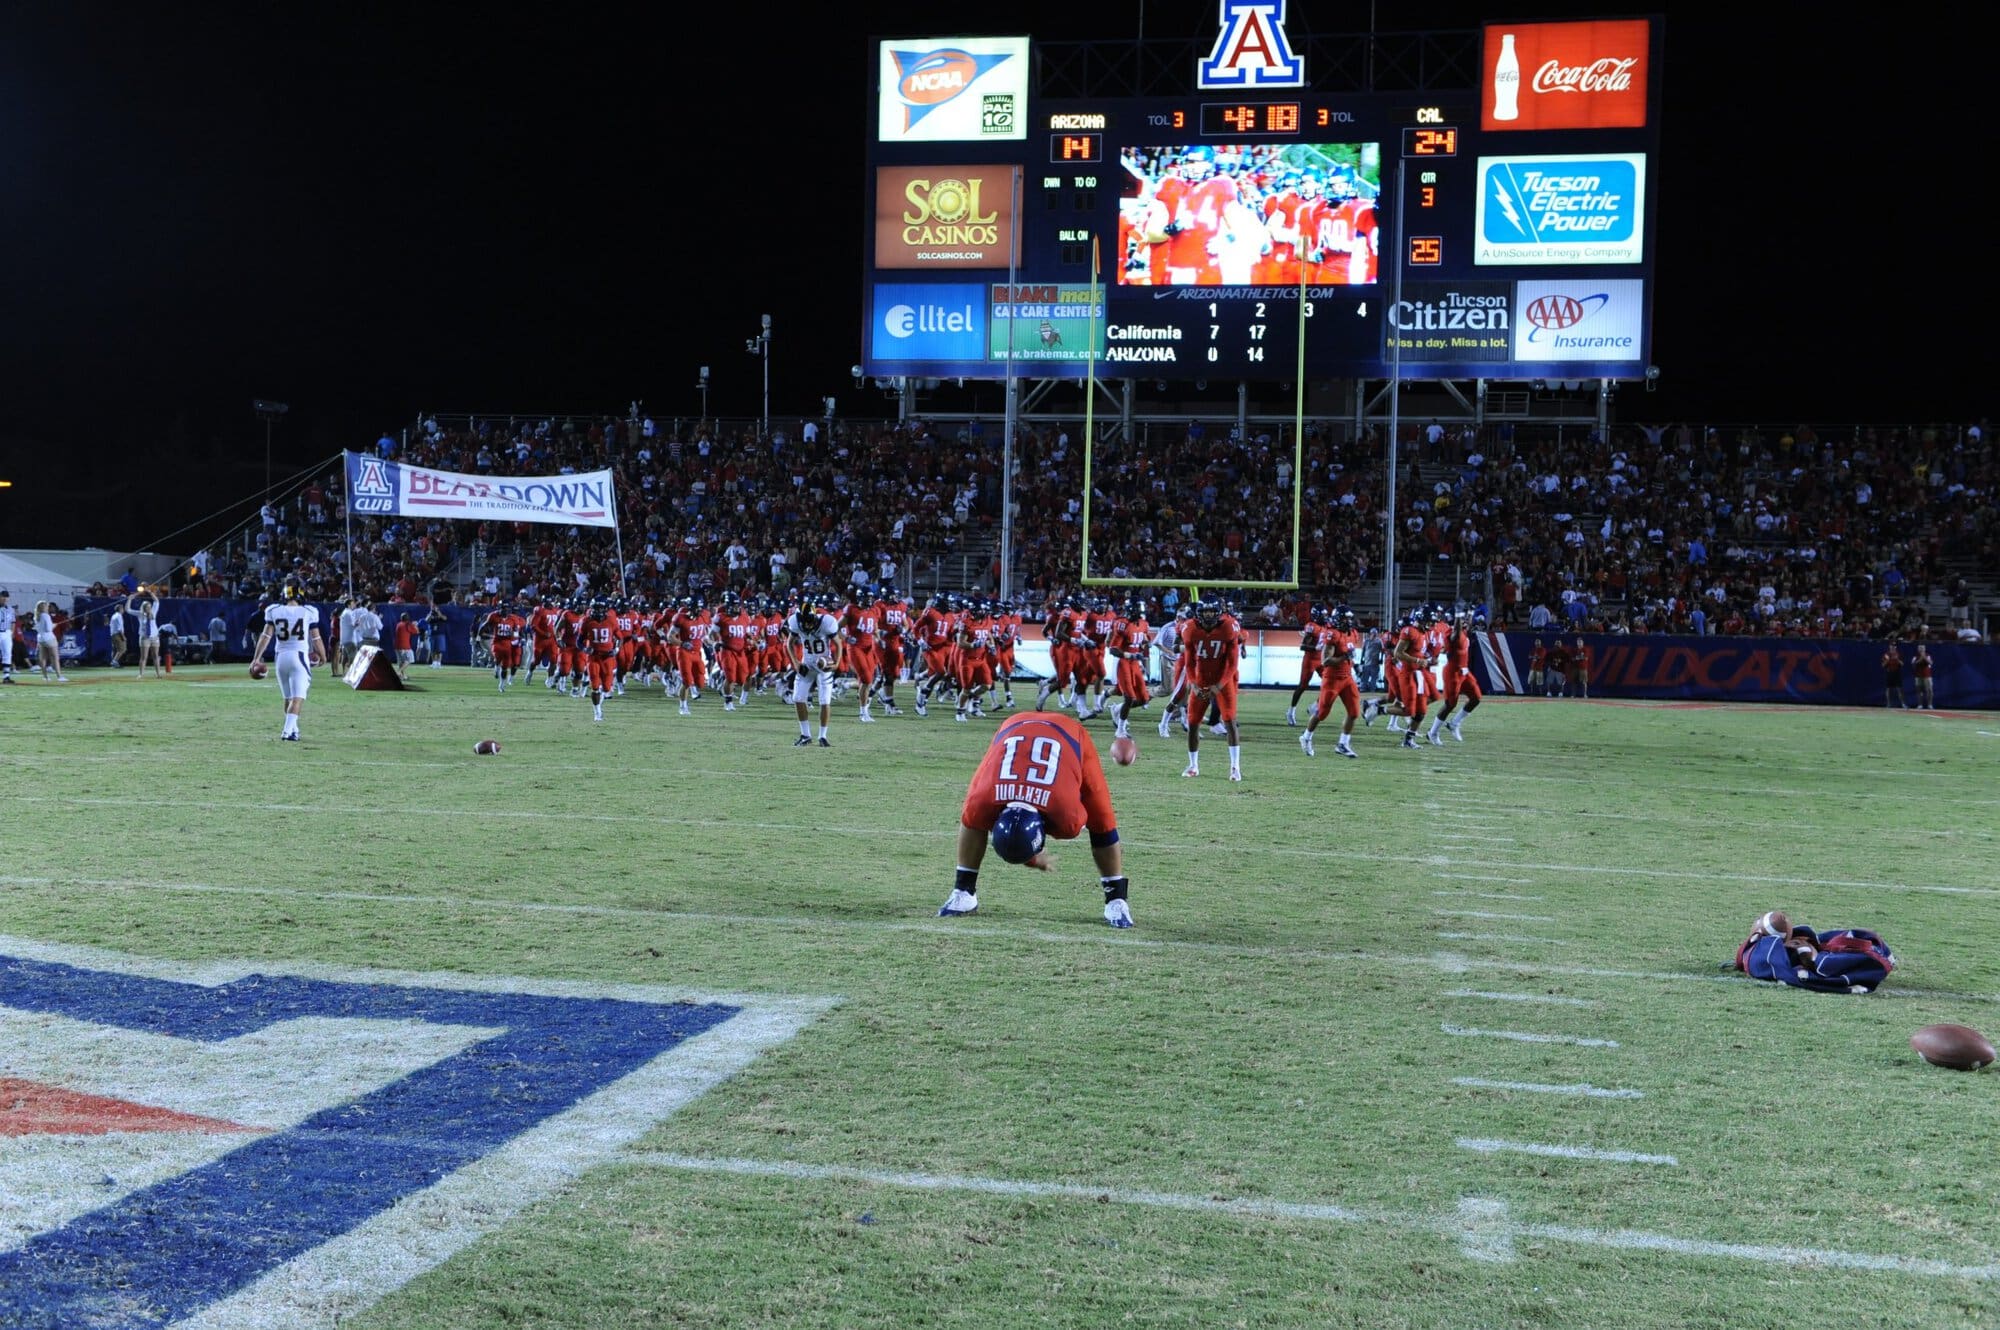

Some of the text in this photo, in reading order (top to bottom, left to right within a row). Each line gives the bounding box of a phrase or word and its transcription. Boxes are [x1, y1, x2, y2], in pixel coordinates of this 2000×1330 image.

[1198, 0, 1304, 89] A
[910, 70, 963, 93] NCAA
[1532, 58, 1638, 93] Coca-Cola
[984, 103, 1012, 113] PAC
[1417, 108, 1444, 123] CAL
[984, 113, 1012, 126] 10
[1050, 114, 1105, 129] ARIZONA
[1148, 112, 1184, 128] TOL 3
[1317, 109, 1354, 125] 3 TOL
[1063, 137, 1090, 159] 14
[1415, 130, 1455, 154] 24
[1044, 177, 1060, 188] DWN
[1075, 177, 1096, 188] TO GO
[1421, 172, 1436, 184] QTR
[1522, 171, 1600, 192] Tucson
[903, 179, 998, 225] SOL
[1422, 188, 1434, 206] 3
[1530, 192, 1621, 211] Electric
[1537, 212, 1619, 231] Power
[902, 225, 998, 245] CASINOS
[1060, 231, 1088, 241] BALL ON
[917, 252, 983, 260] SOLCASINOS.COM
[1411, 239, 1439, 262] 25
[1482, 247, 1632, 260] A UniSource Energy Company
[993, 286, 1103, 303] BRAKE max
[1446, 292, 1506, 307] Tucson
[1021, 306, 1050, 317] CARE
[1208, 303, 1367, 317] 1 2 3 4
[1388, 301, 1508, 330] Citizen
[1532, 296, 1578, 329] AAA
[885, 304, 973, 338] alltel
[1107, 325, 1266, 339] California 7 17
[1387, 338, 1413, 347] Miss
[1425, 338, 1448, 349] day.
[1451, 338, 1477, 347] Miss
[1490, 338, 1508, 347] lot.
[1554, 335, 1632, 348] Insurance
[1105, 347, 1264, 362] ARIZONA 0 14
[355, 457, 393, 497] A
[355, 498, 393, 512] CLUB
[469, 501, 483, 509] THE
[487, 501, 529, 511] TRADITION
[857, 616, 874, 633] 48
[886, 610, 902, 624] 66
[275, 618, 304, 641] 34
[592, 628, 610, 643] 19
[728, 624, 745, 639] 98
[934, 620, 949, 637] 11
[1196, 640, 1222, 659] 47
